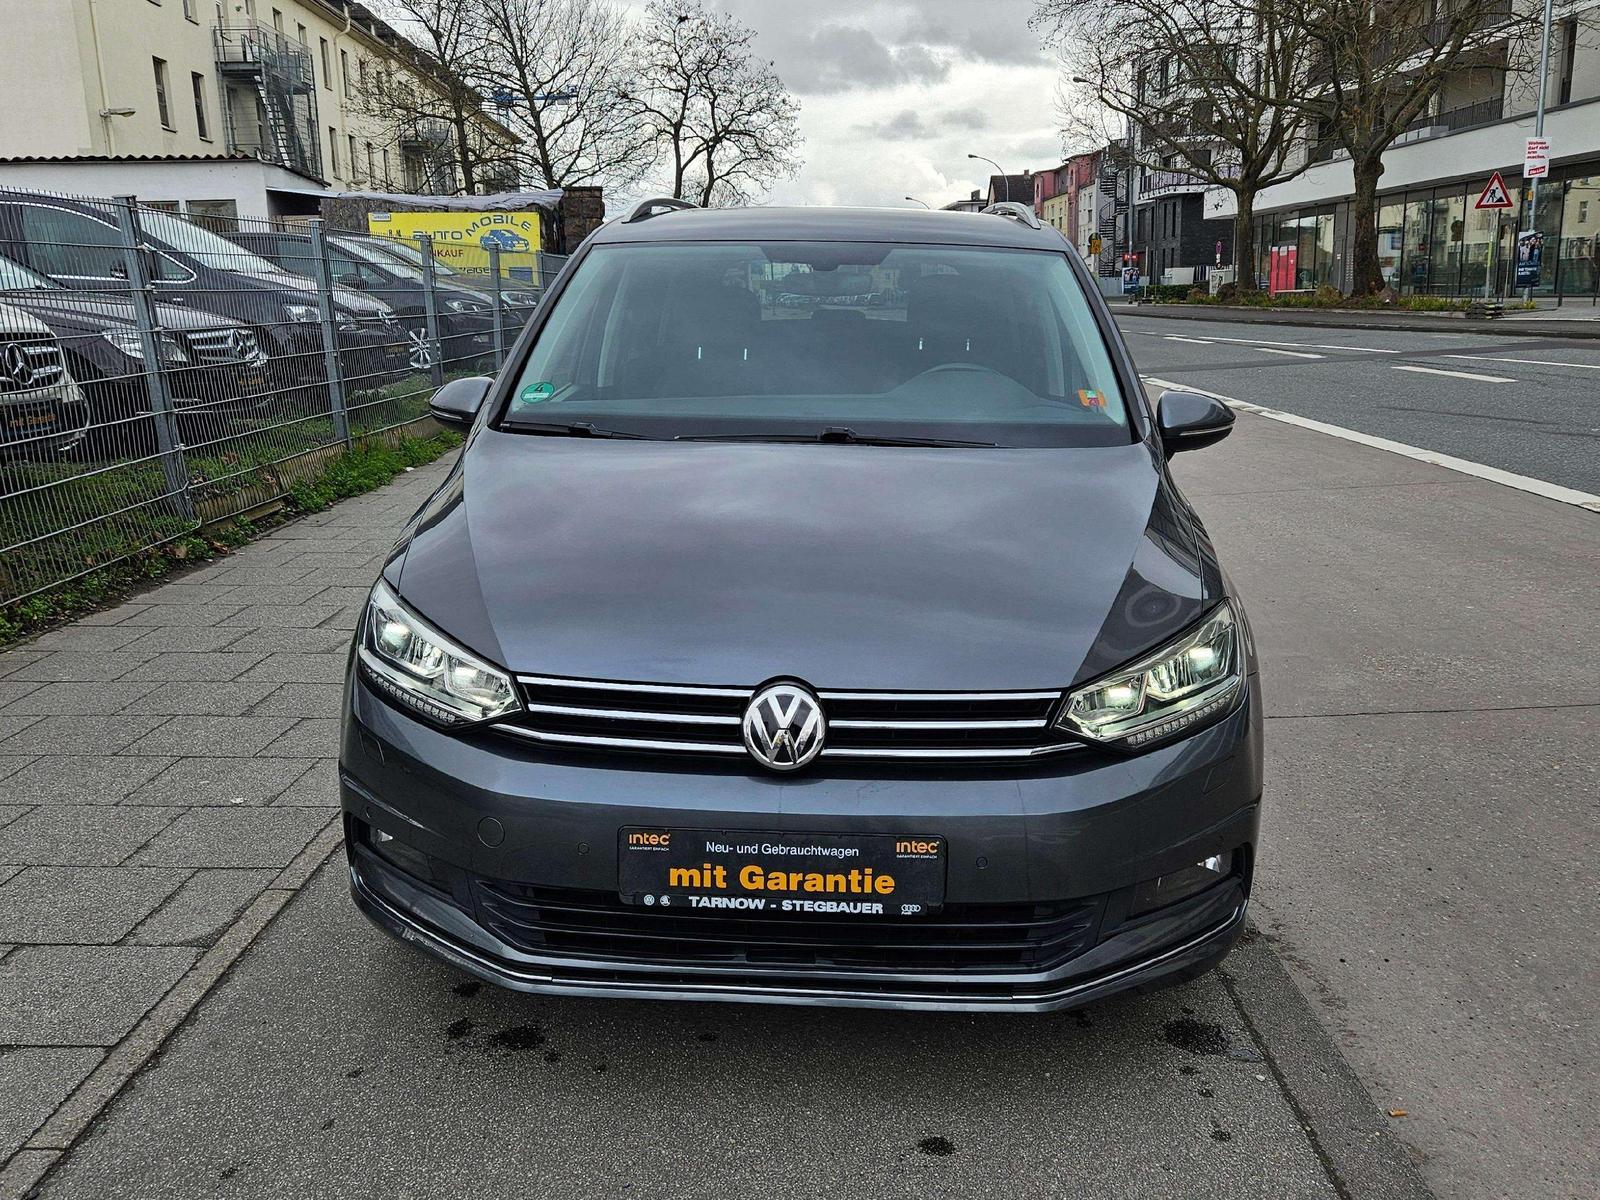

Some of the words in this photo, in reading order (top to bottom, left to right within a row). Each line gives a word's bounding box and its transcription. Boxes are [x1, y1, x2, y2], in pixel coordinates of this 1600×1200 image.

[465, 214, 532, 237] MOBILE
[534, 383, 543, 392] 4
[629, 833, 671, 845] intec
[896, 841, 940, 853] intec
[705, 840, 734, 853] Neu-
[736, 842, 758, 855] und
[761, 843, 860, 858] Gebrauchtwagen
[669, 863, 728, 889] mit
[739, 865, 896, 895] Garantie
[688, 895, 766, 911] TARNOW
[781, 899, 884, 915] STEGBAUER
